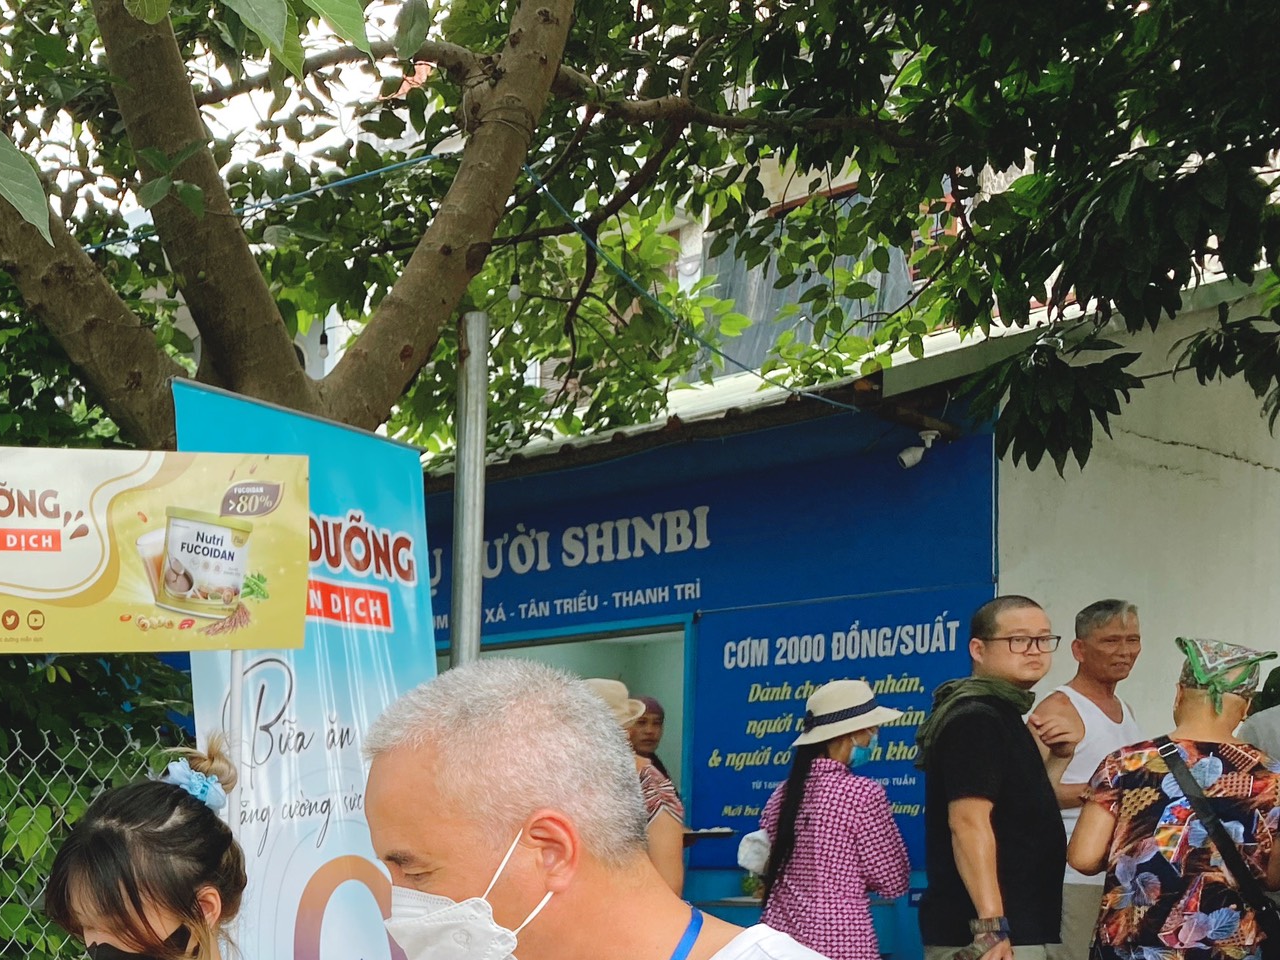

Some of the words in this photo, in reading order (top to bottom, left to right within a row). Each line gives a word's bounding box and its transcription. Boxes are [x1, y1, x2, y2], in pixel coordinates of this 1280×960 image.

[229, 494, 273, 513] >80%
[7, 532, 54, 551] DỊCH
[196, 531, 224, 546] Nutri
[482, 522, 551, 579] ƯỜI
[562, 505, 710, 568] SHINBI
[181, 542, 235, 561] FUCOIDAN
[331, 591, 382, 622] DỊCH
[485, 602, 507, 624] XÁ
[518, 599, 550, 619] TÂN
[612, 586, 670, 609] THANH
[723, 636, 769, 670] CƠM
[775, 633, 825, 666] 2000
[748, 681, 792, 703] Dành
[222, 658, 314, 790] Bữa
[326, 716, 357, 750] ăn
[746, 713, 793, 739] người
[708, 749, 722, 767] &
[725, 746, 772, 771] người
